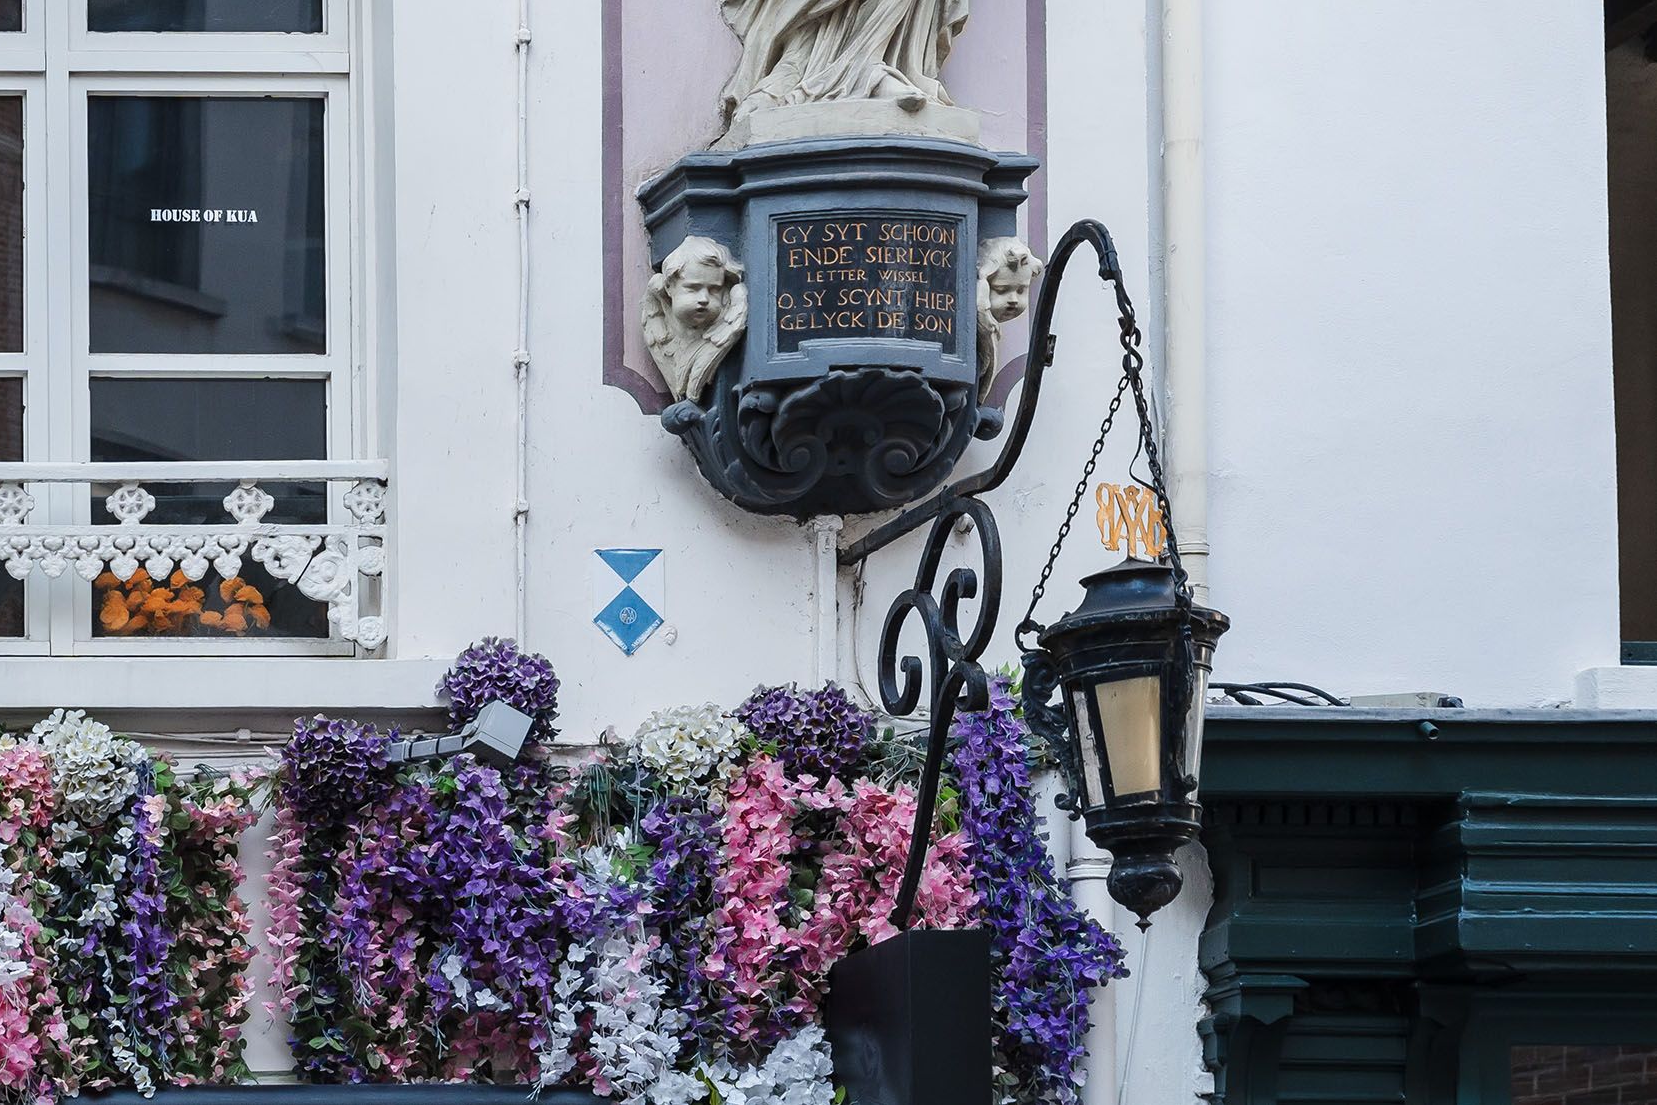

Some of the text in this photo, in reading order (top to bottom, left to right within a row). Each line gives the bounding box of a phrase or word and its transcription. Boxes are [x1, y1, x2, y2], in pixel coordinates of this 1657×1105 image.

[151, 209, 258, 223] HOUSE OF KUA
[782, 223, 955, 245] GY SYT SCHOON
[788, 246, 952, 268] ENDE SIERLYCK
[807, 269, 928, 283] LETTER WISSEL
[802, 290, 827, 307] SY
[837, 289, 905, 306] SCYNT
[915, 291, 955, 312] HIER
[780, 311, 952, 335] GELYCK DE SON
